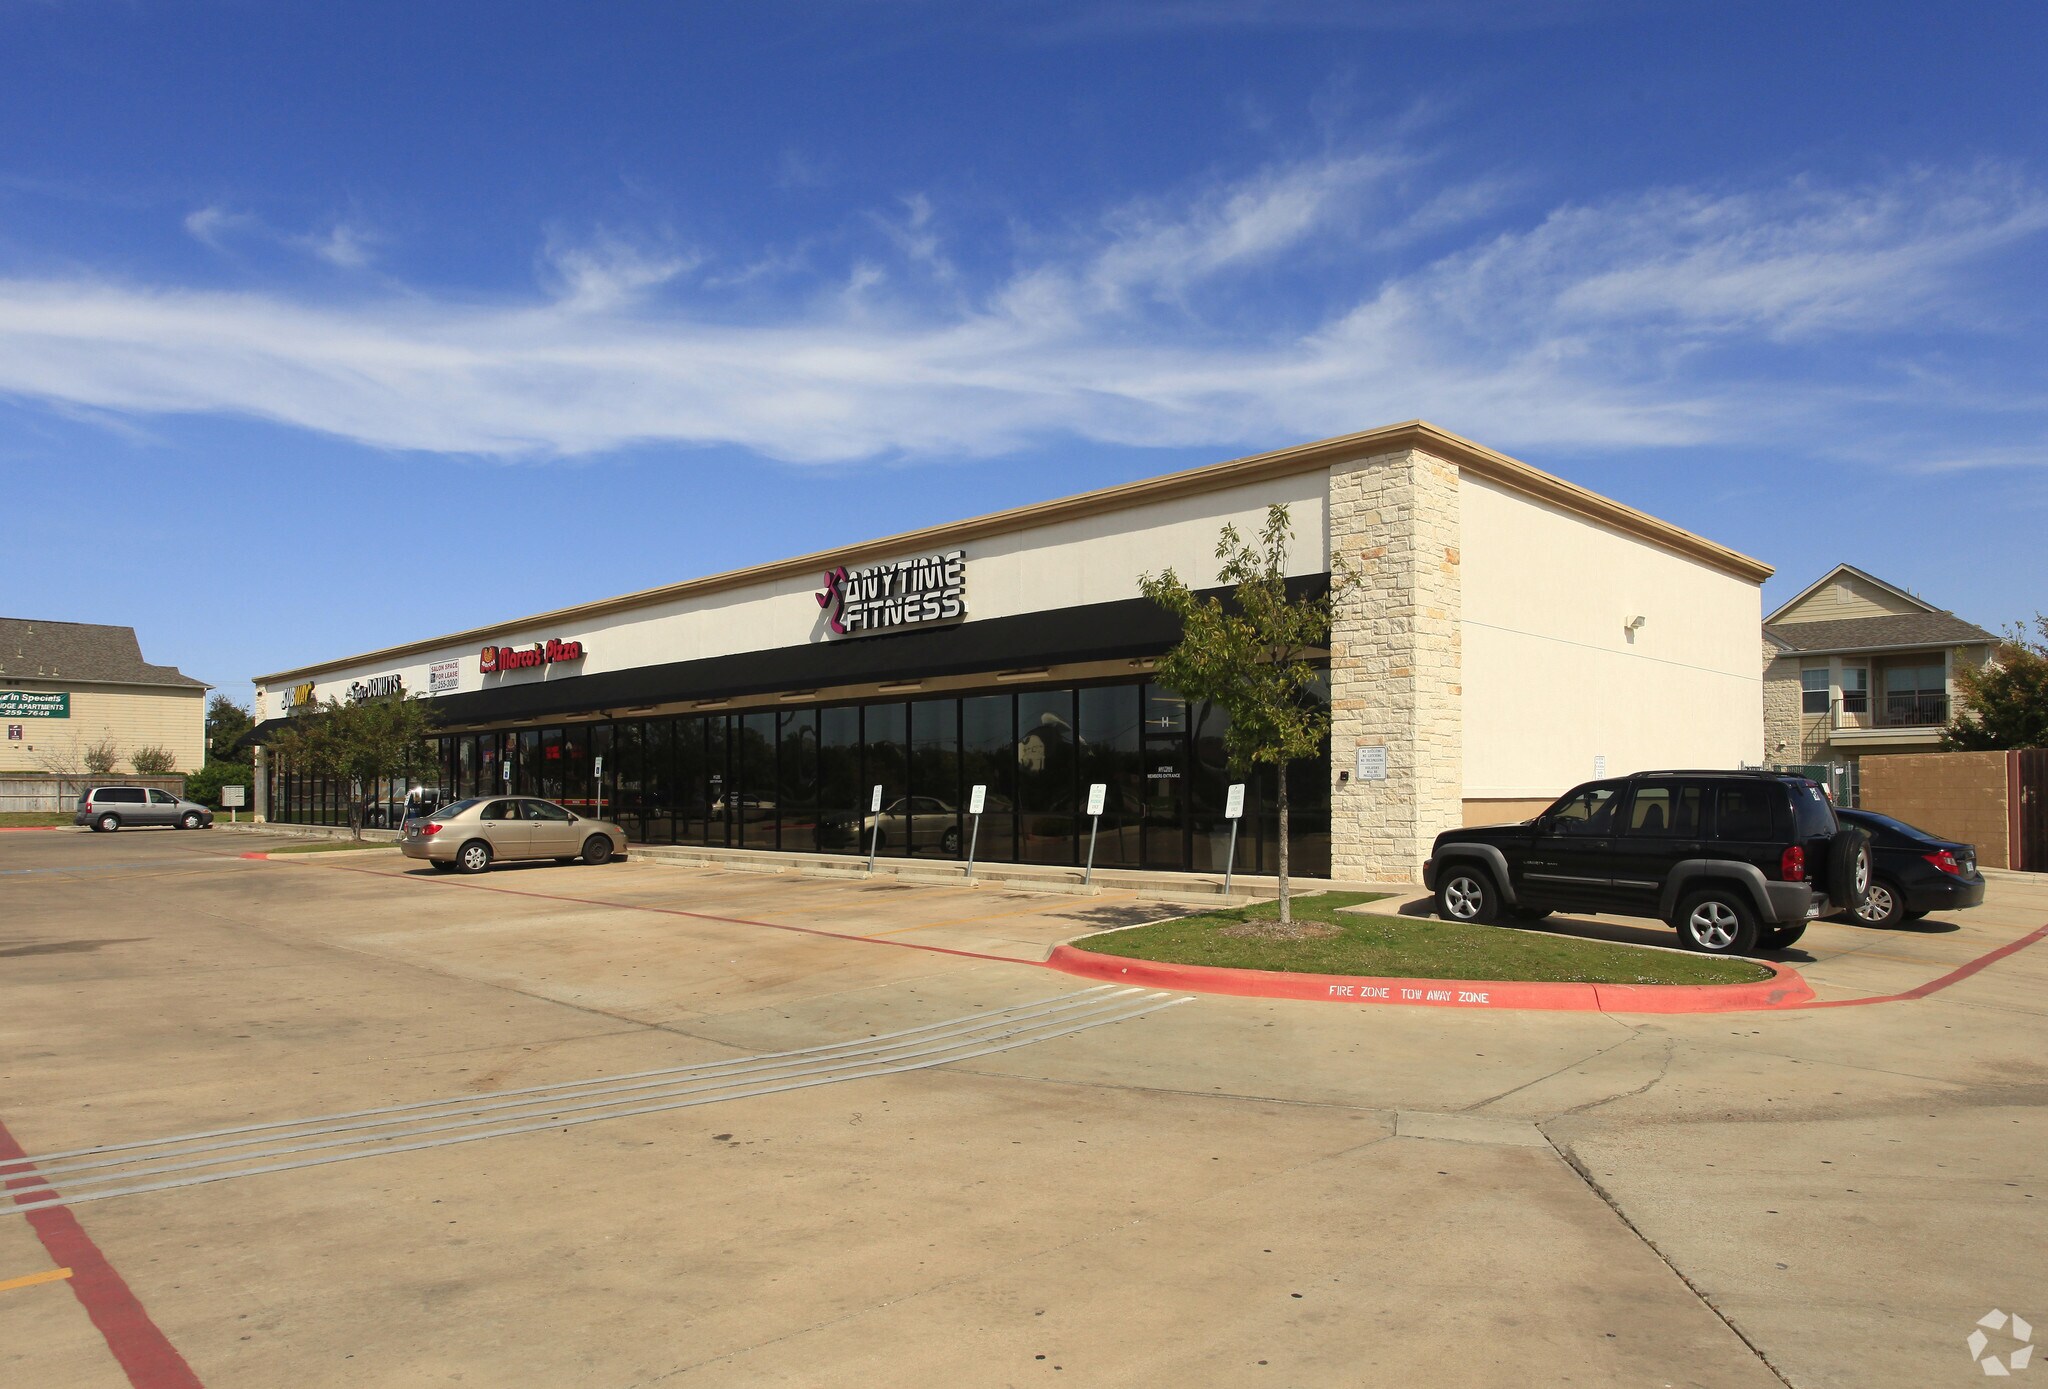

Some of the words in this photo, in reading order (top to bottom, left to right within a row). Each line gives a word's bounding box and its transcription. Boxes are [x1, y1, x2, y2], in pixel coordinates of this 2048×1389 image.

[845, 550, 966, 604] ANYTIME
[846, 587, 966, 632] FITNESS
[501, 642, 544, 670] Marco's
[545, 638, 582, 663] Pizza
[22, 694, 61, 702] Specials
[281, 681, 315, 710] SUBWAY
[367, 674, 401, 697] DONUTS
[1162, 717, 1168, 727] H
[1329, 985, 1354, 997] FIRE
[1360, 986, 1390, 999] ZONE
[1401, 988, 1422, 1000] TOW
[1427, 989, 1451, 1002] AWAY
[1458, 991, 1489, 1004] ZONE
